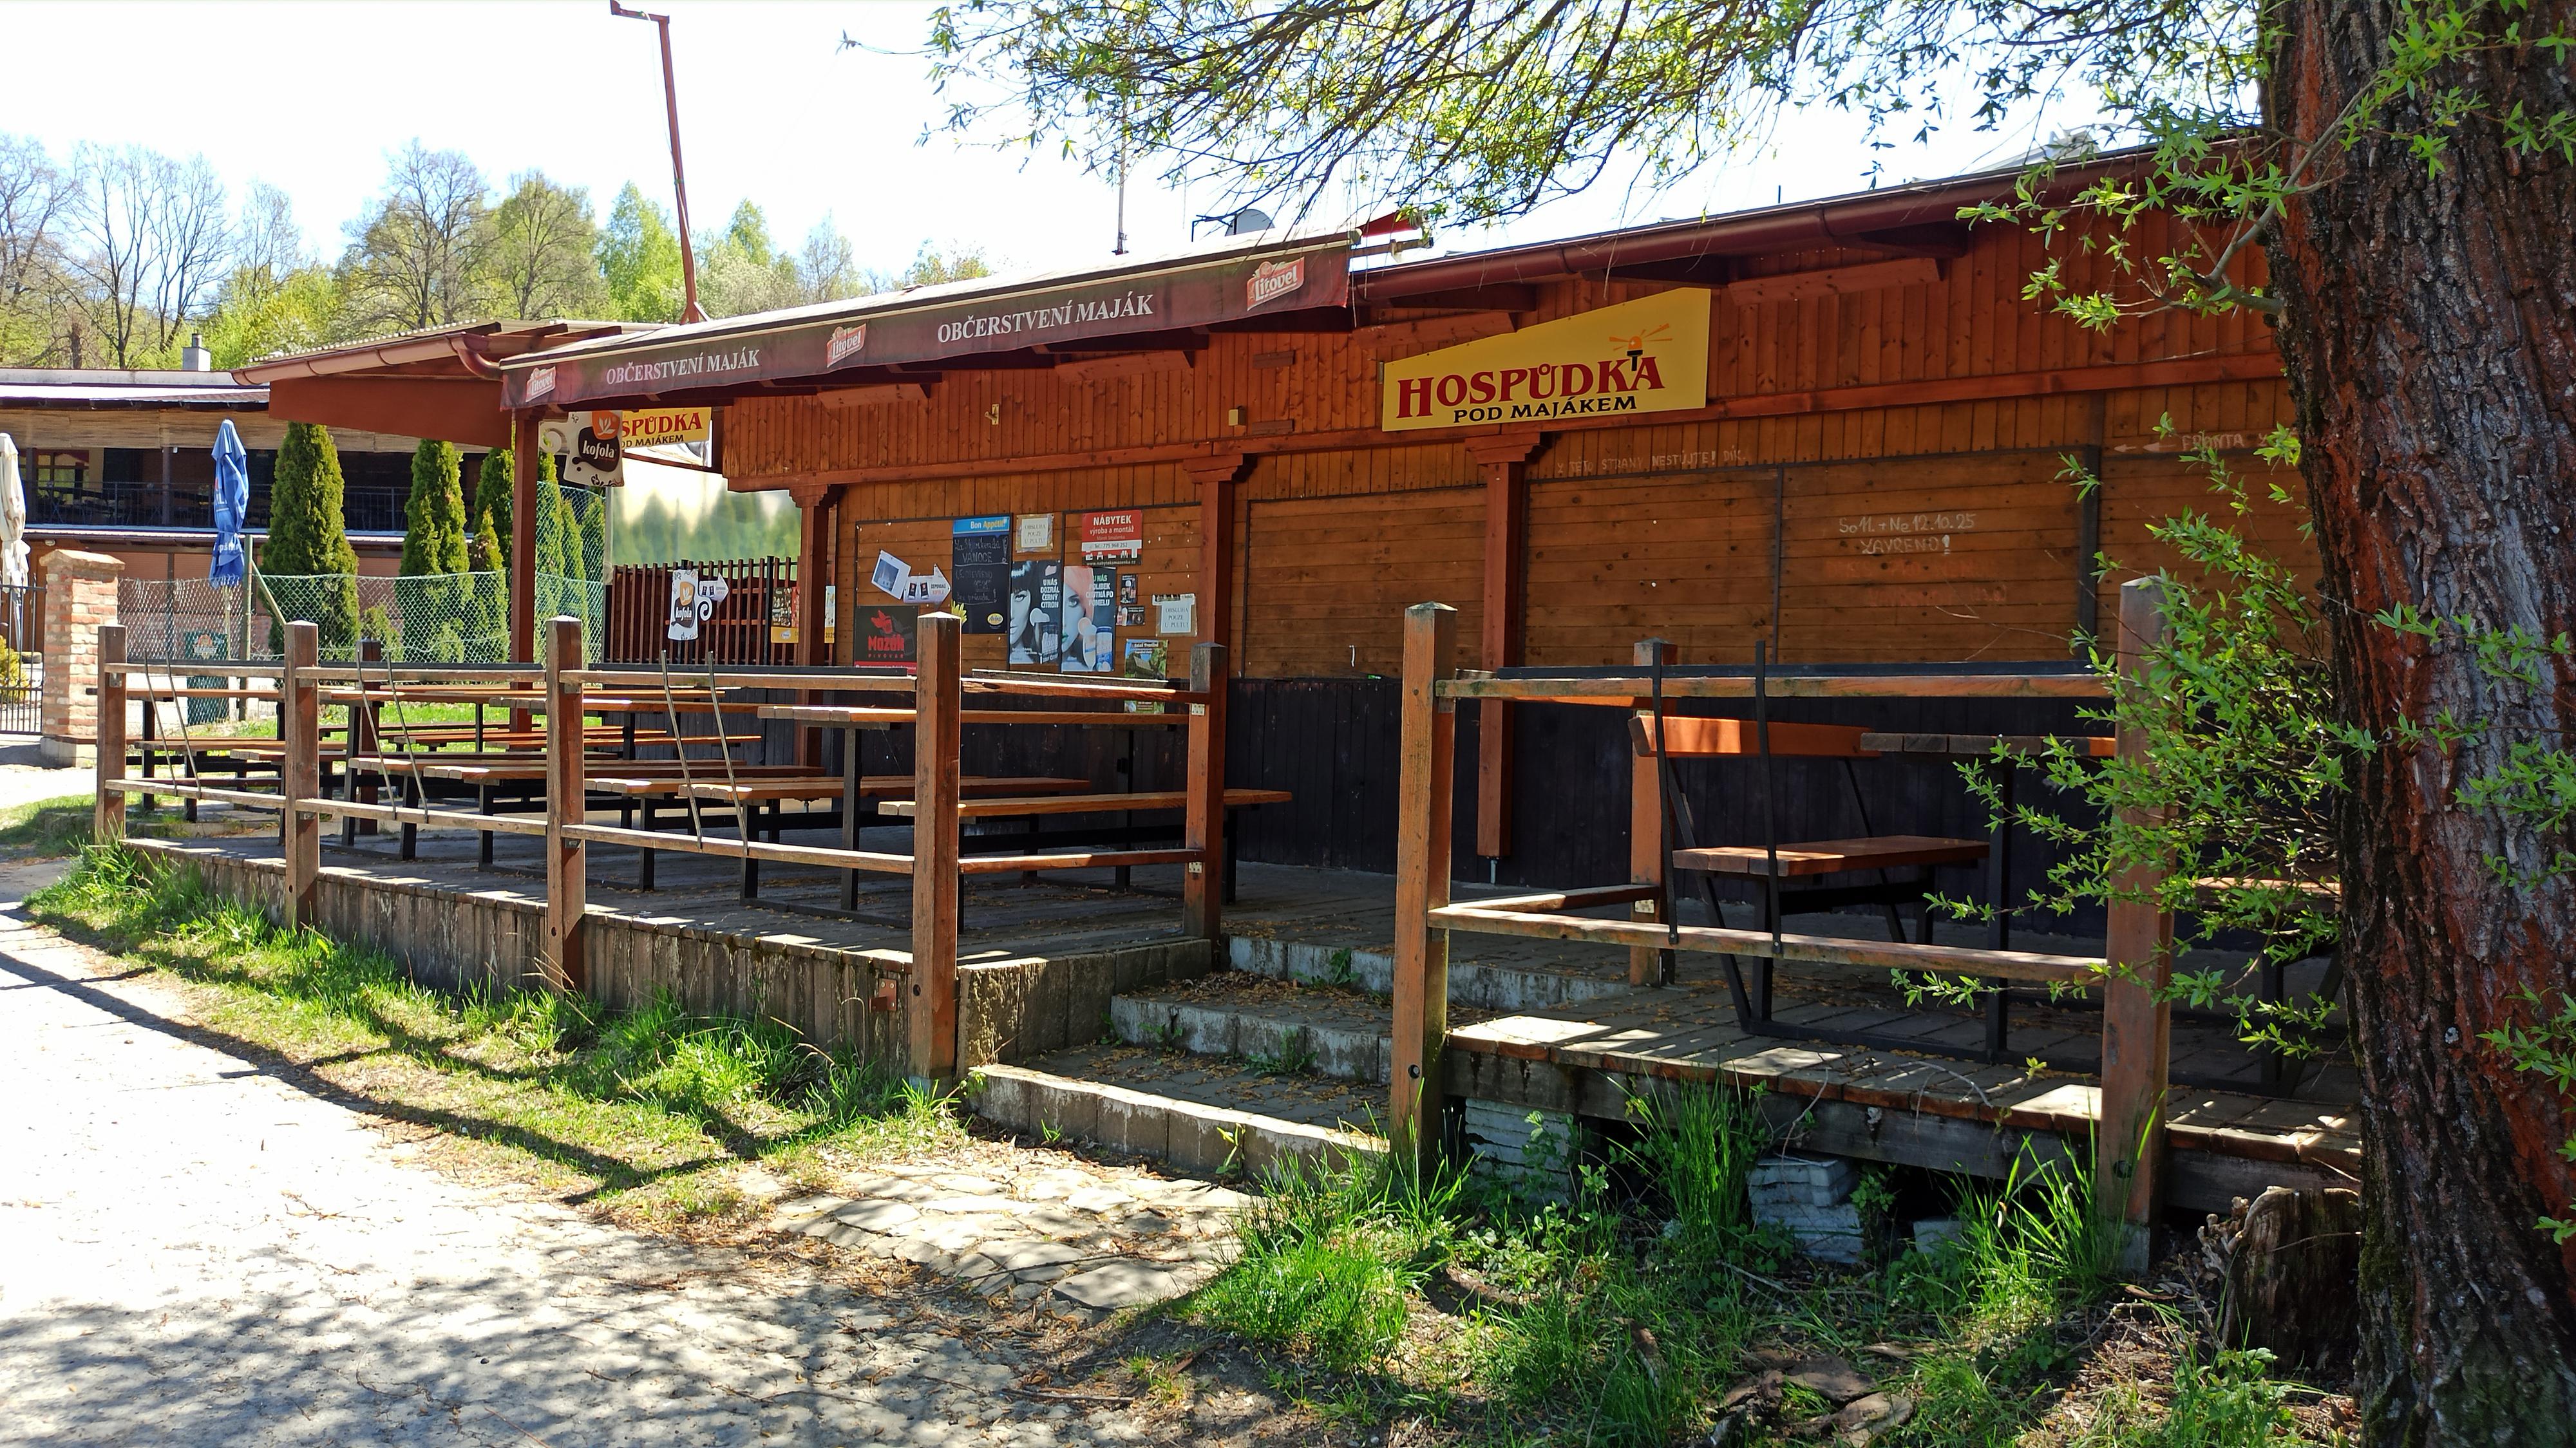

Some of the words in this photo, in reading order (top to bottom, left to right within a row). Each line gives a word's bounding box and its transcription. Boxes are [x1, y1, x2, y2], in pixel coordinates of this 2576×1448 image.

[1255, 265, 1297, 301] Litovel
[937, 299, 1072, 343] OBČERSTVENÍ
[1075, 291, 1154, 323] MAJÁK
[833, 329, 862, 359] Litovel
[606, 352, 704, 384] OBČERSTVENÍ
[706, 346, 760, 372] MAJÁK
[1396, 356, 1665, 418] HOSPŮDKA
[1453, 406, 1502, 423] POD
[1510, 395, 1637, 419] MAJÁKEM
[621, 412, 703, 438] SPŮDKA
[635, 434, 685, 446] MAJÁKEM
[582, 440, 615, 460] kofola
[971, 521, 982, 529] Bon
[1093, 514, 1132, 526] NÁBYTEK
[1889, 516, 1911, 533] Ne
[1090, 527, 1108, 536] výroba
[962, 549, 992, 563] VÁNOCE
[1047, 578, 1057, 586] NÁS
[1042, 592, 1058, 601] ČERNÝ
[675, 606, 692, 621] kofola
